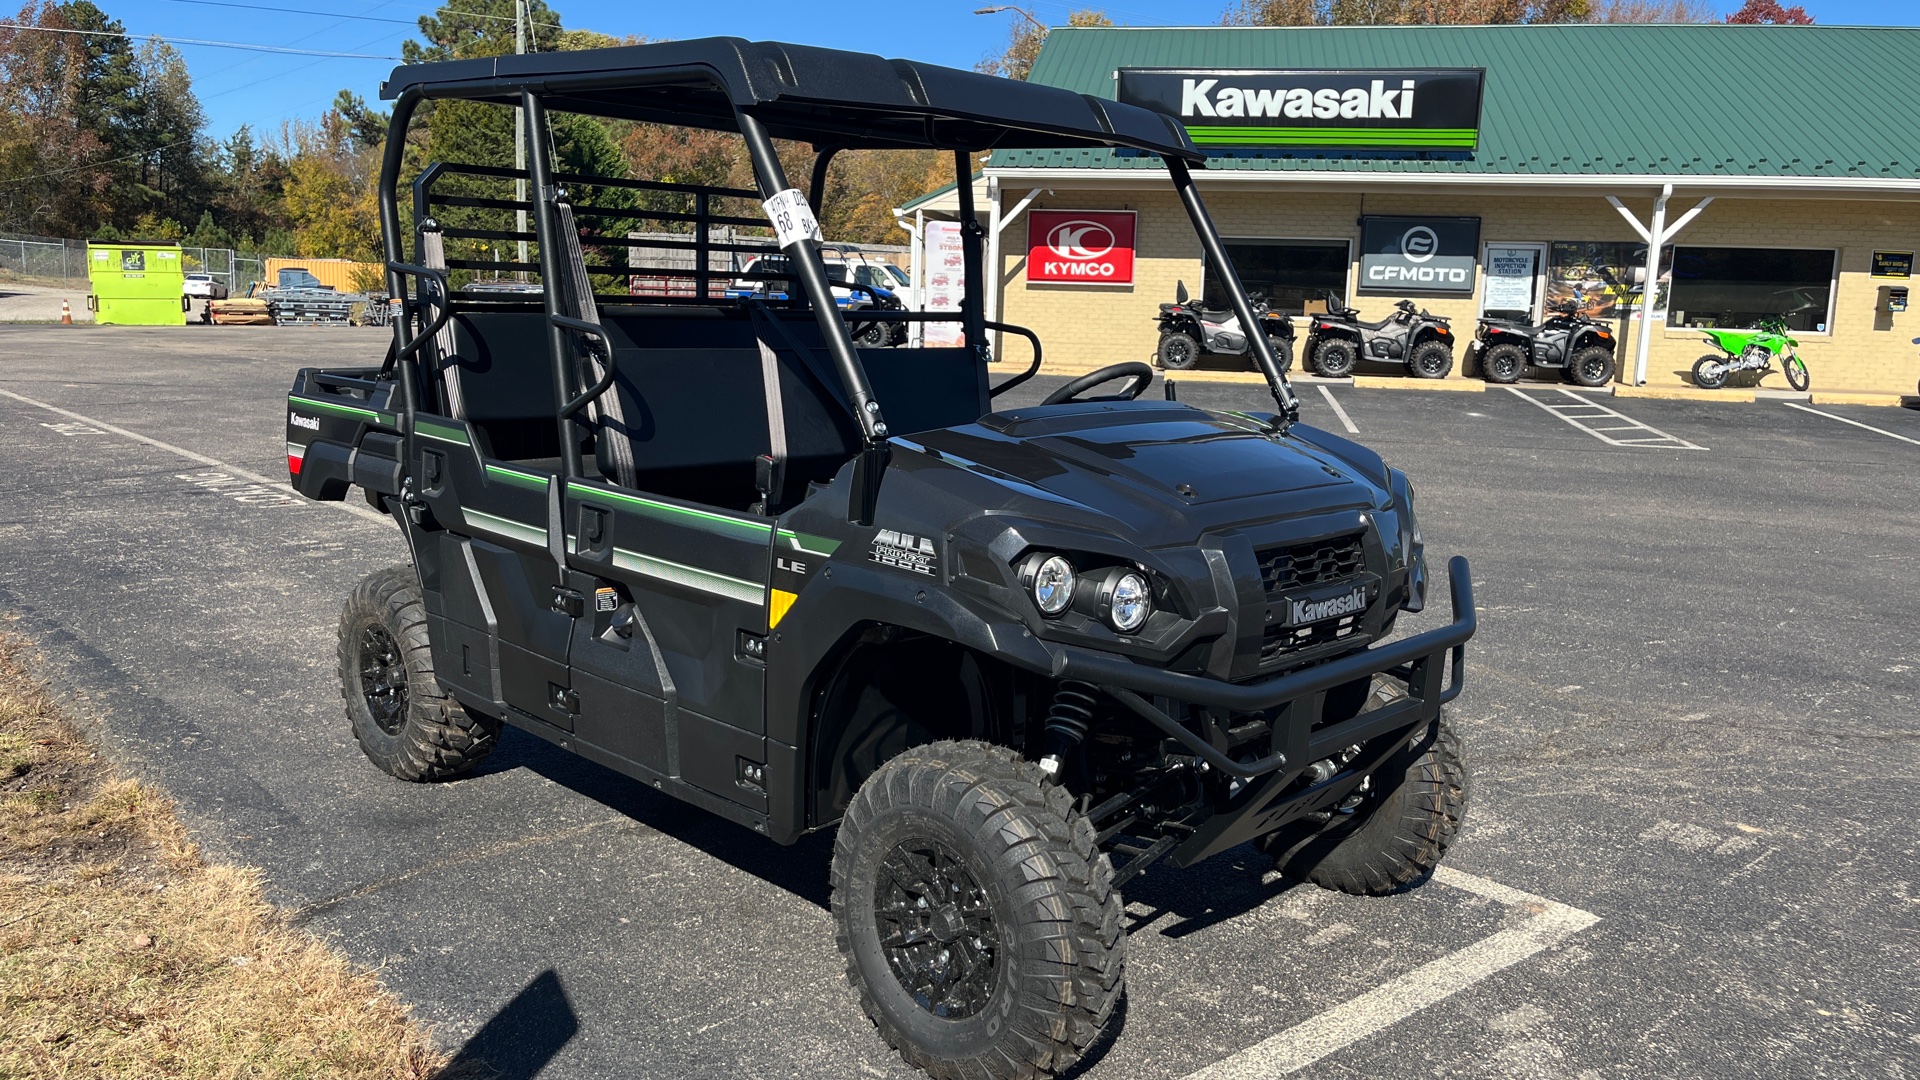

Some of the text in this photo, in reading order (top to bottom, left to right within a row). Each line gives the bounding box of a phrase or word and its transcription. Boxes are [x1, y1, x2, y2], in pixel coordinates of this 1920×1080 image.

[1181, 78, 1415, 119] Kawasaki
[777, 211, 793, 233] 68
[1044, 260, 1115, 276] KYMCO
[1369, 265, 1466, 283] CFMOTO
[290, 411, 320, 431] Kawasaki
[871, 528, 937, 559] MULE
[777, 557, 806, 575] LE
[1292, 586, 1366, 625] Kawasaki
